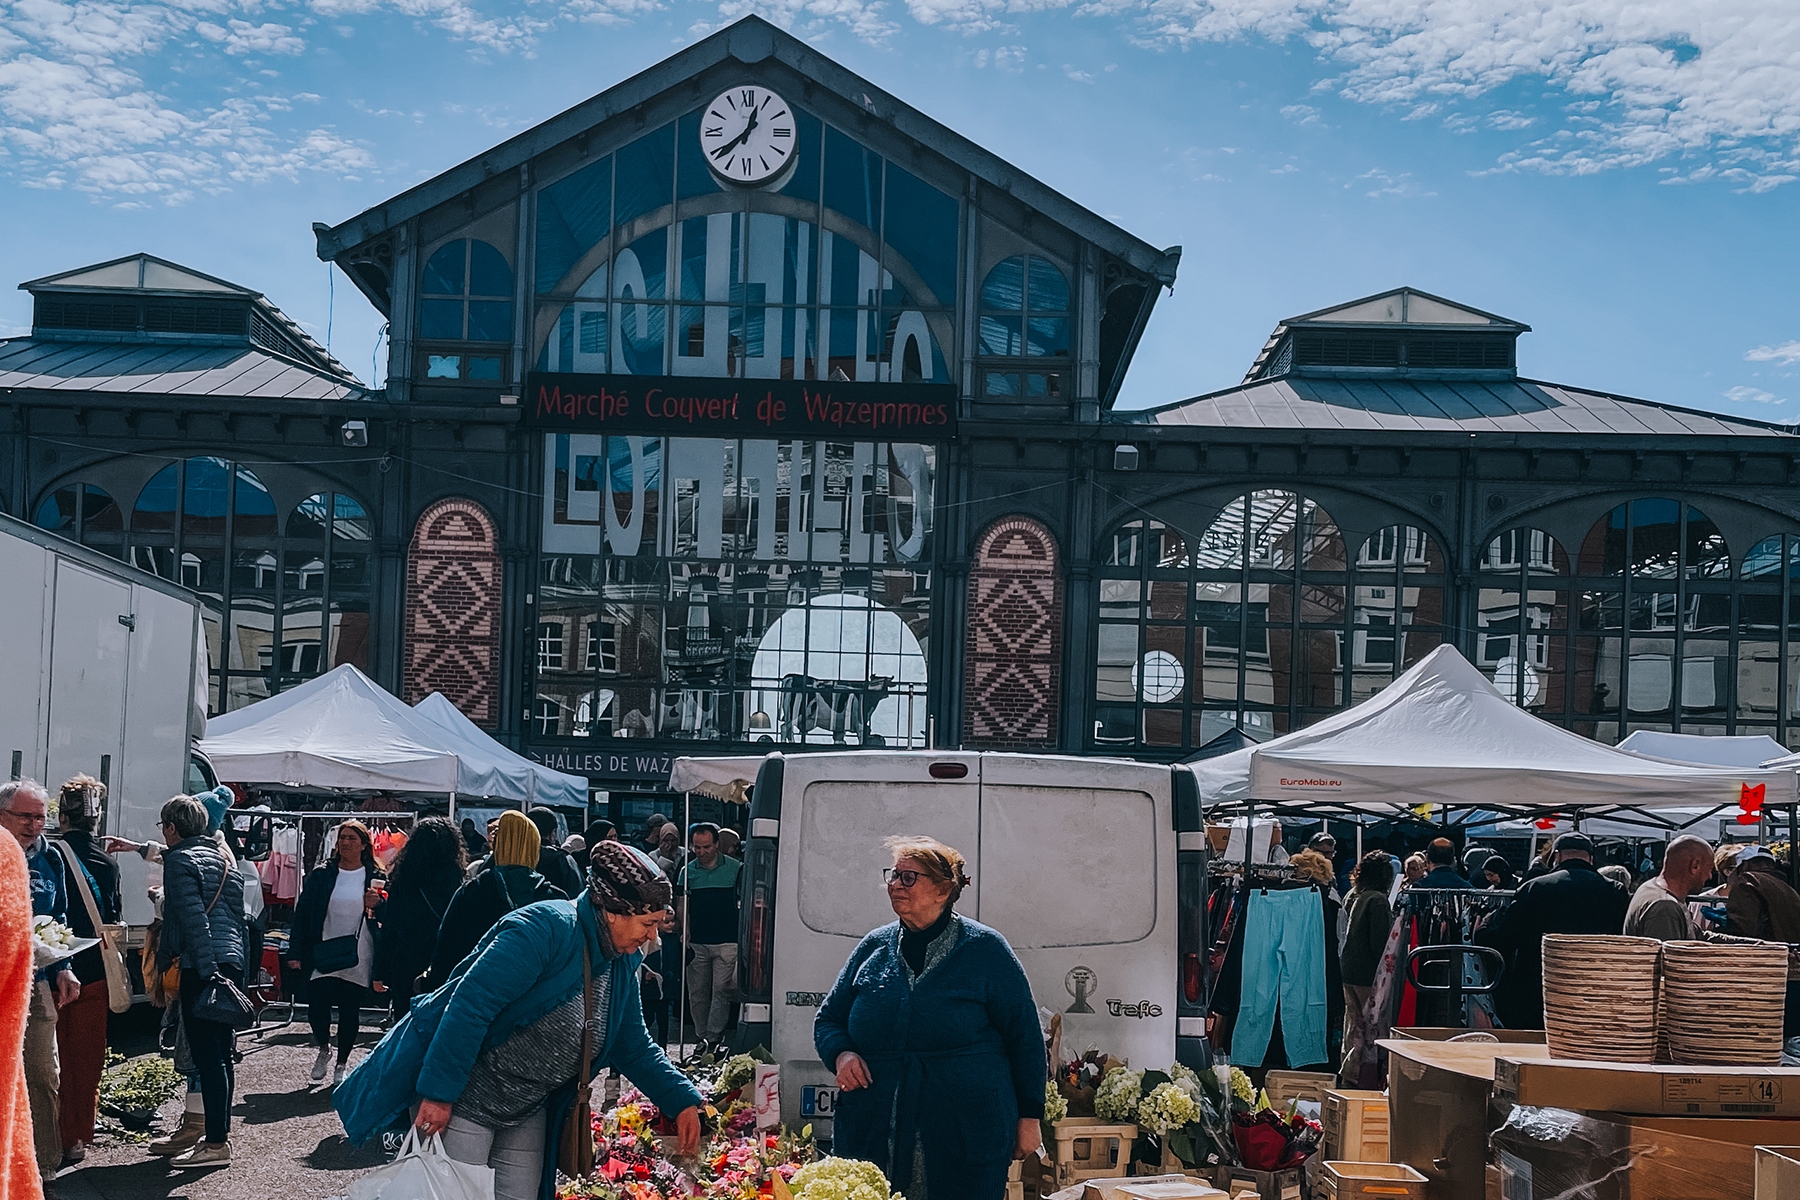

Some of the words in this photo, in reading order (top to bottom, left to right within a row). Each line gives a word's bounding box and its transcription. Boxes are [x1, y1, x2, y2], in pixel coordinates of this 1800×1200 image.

[536, 385, 630, 421] Marché
[645, 388, 740, 424] Couvert
[756, 391, 787, 427] de
[802, 387, 948, 429] Wazemmes
[545, 753, 603, 771] HALLES
[610, 756, 629, 772] DE
[635, 756, 676, 774] WAZ
[1105, 998, 1163, 1020] Trafic
[1759, 1081, 1773, 1100] 14
